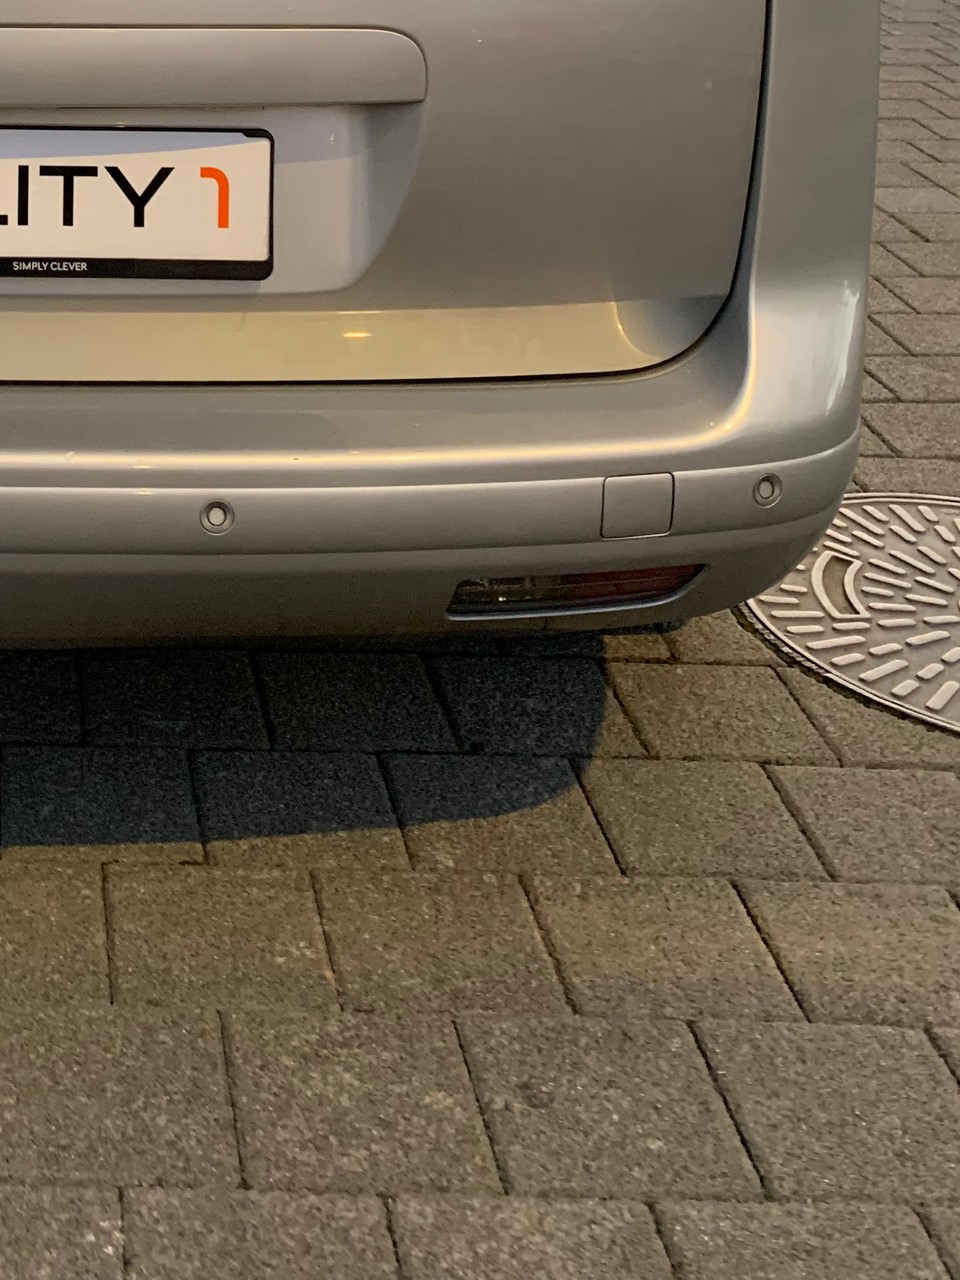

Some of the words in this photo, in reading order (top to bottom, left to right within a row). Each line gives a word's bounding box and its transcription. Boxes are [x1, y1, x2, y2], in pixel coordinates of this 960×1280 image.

[200, 166, 230, 229] 1
[13, 261, 49, 271] SIMPLY
[50, 261, 88, 271] CLEVER
